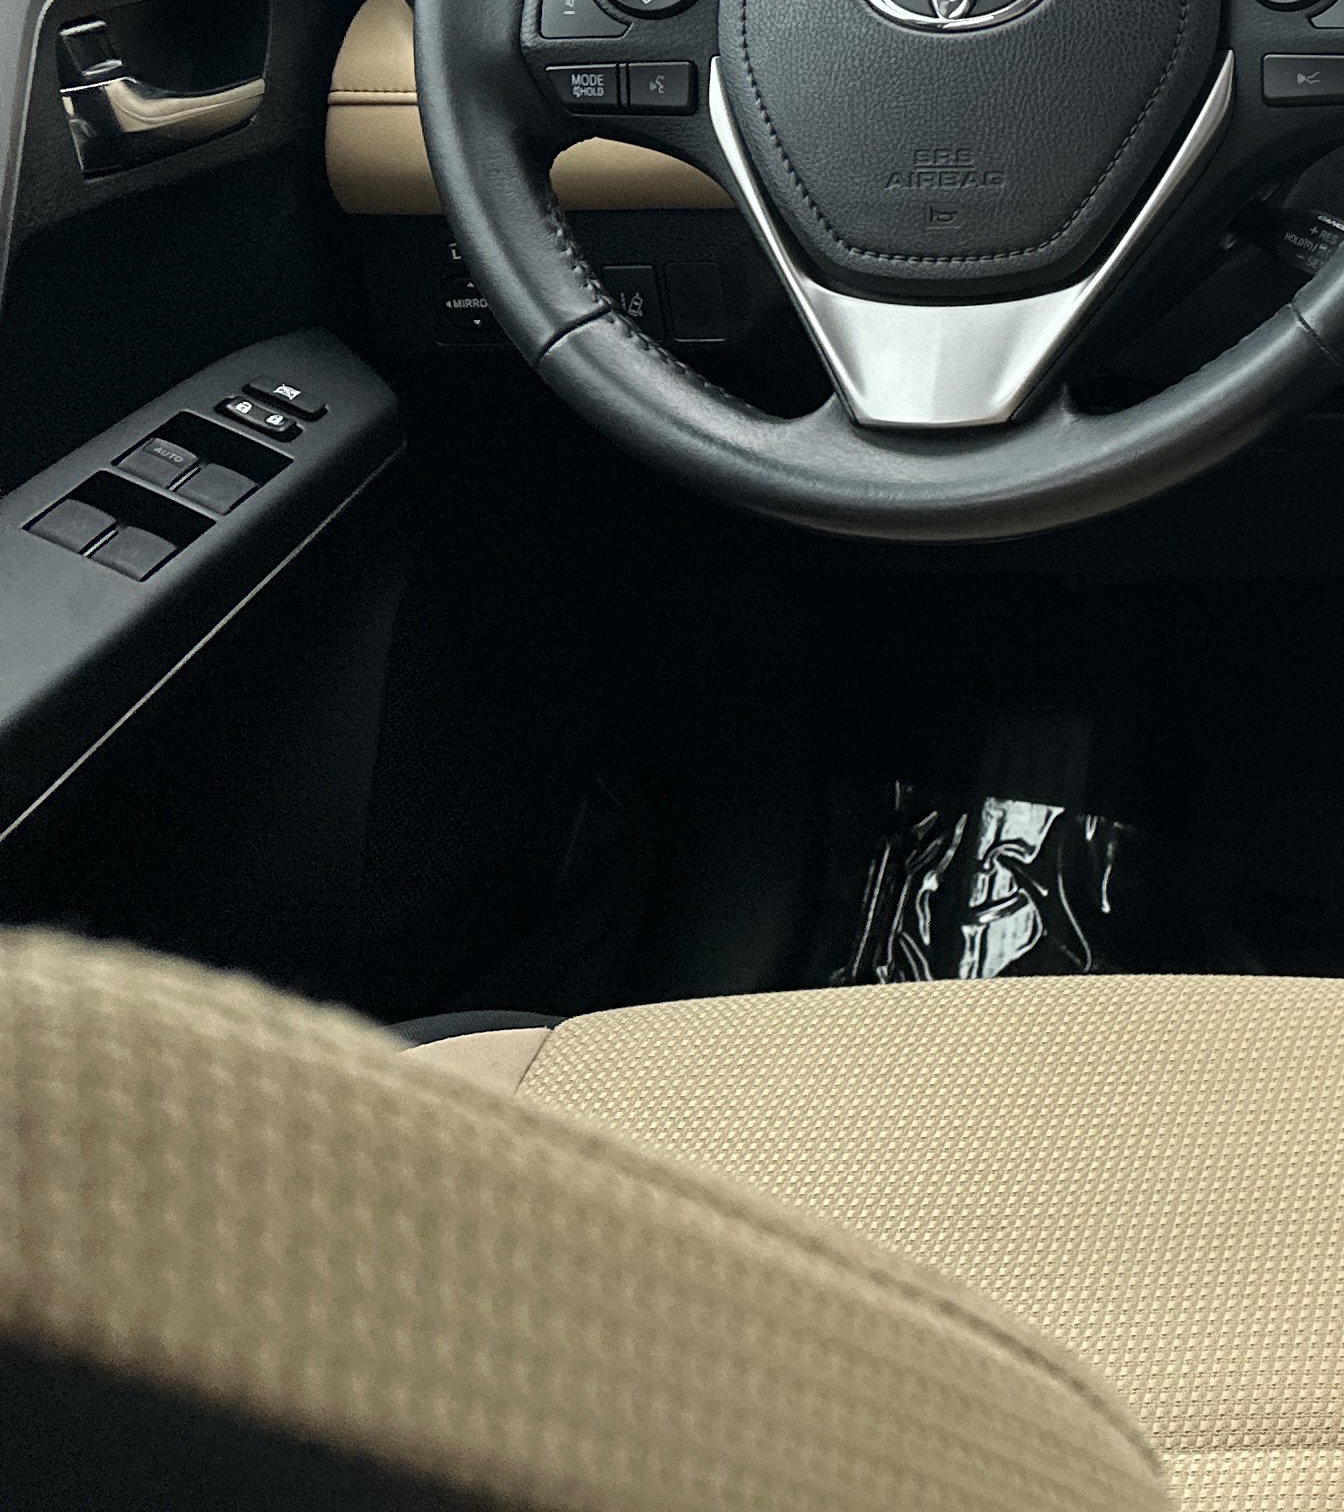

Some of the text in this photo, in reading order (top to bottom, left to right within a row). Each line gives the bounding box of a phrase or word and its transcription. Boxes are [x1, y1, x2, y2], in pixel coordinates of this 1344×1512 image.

[571, 73, 605, 86] MODE
[914, 147, 975, 166] SRS
[884, 169, 1006, 190] AIRBAG
[453, 298, 488, 308] MIRRO
[153, 447, 184, 463] AUTO
